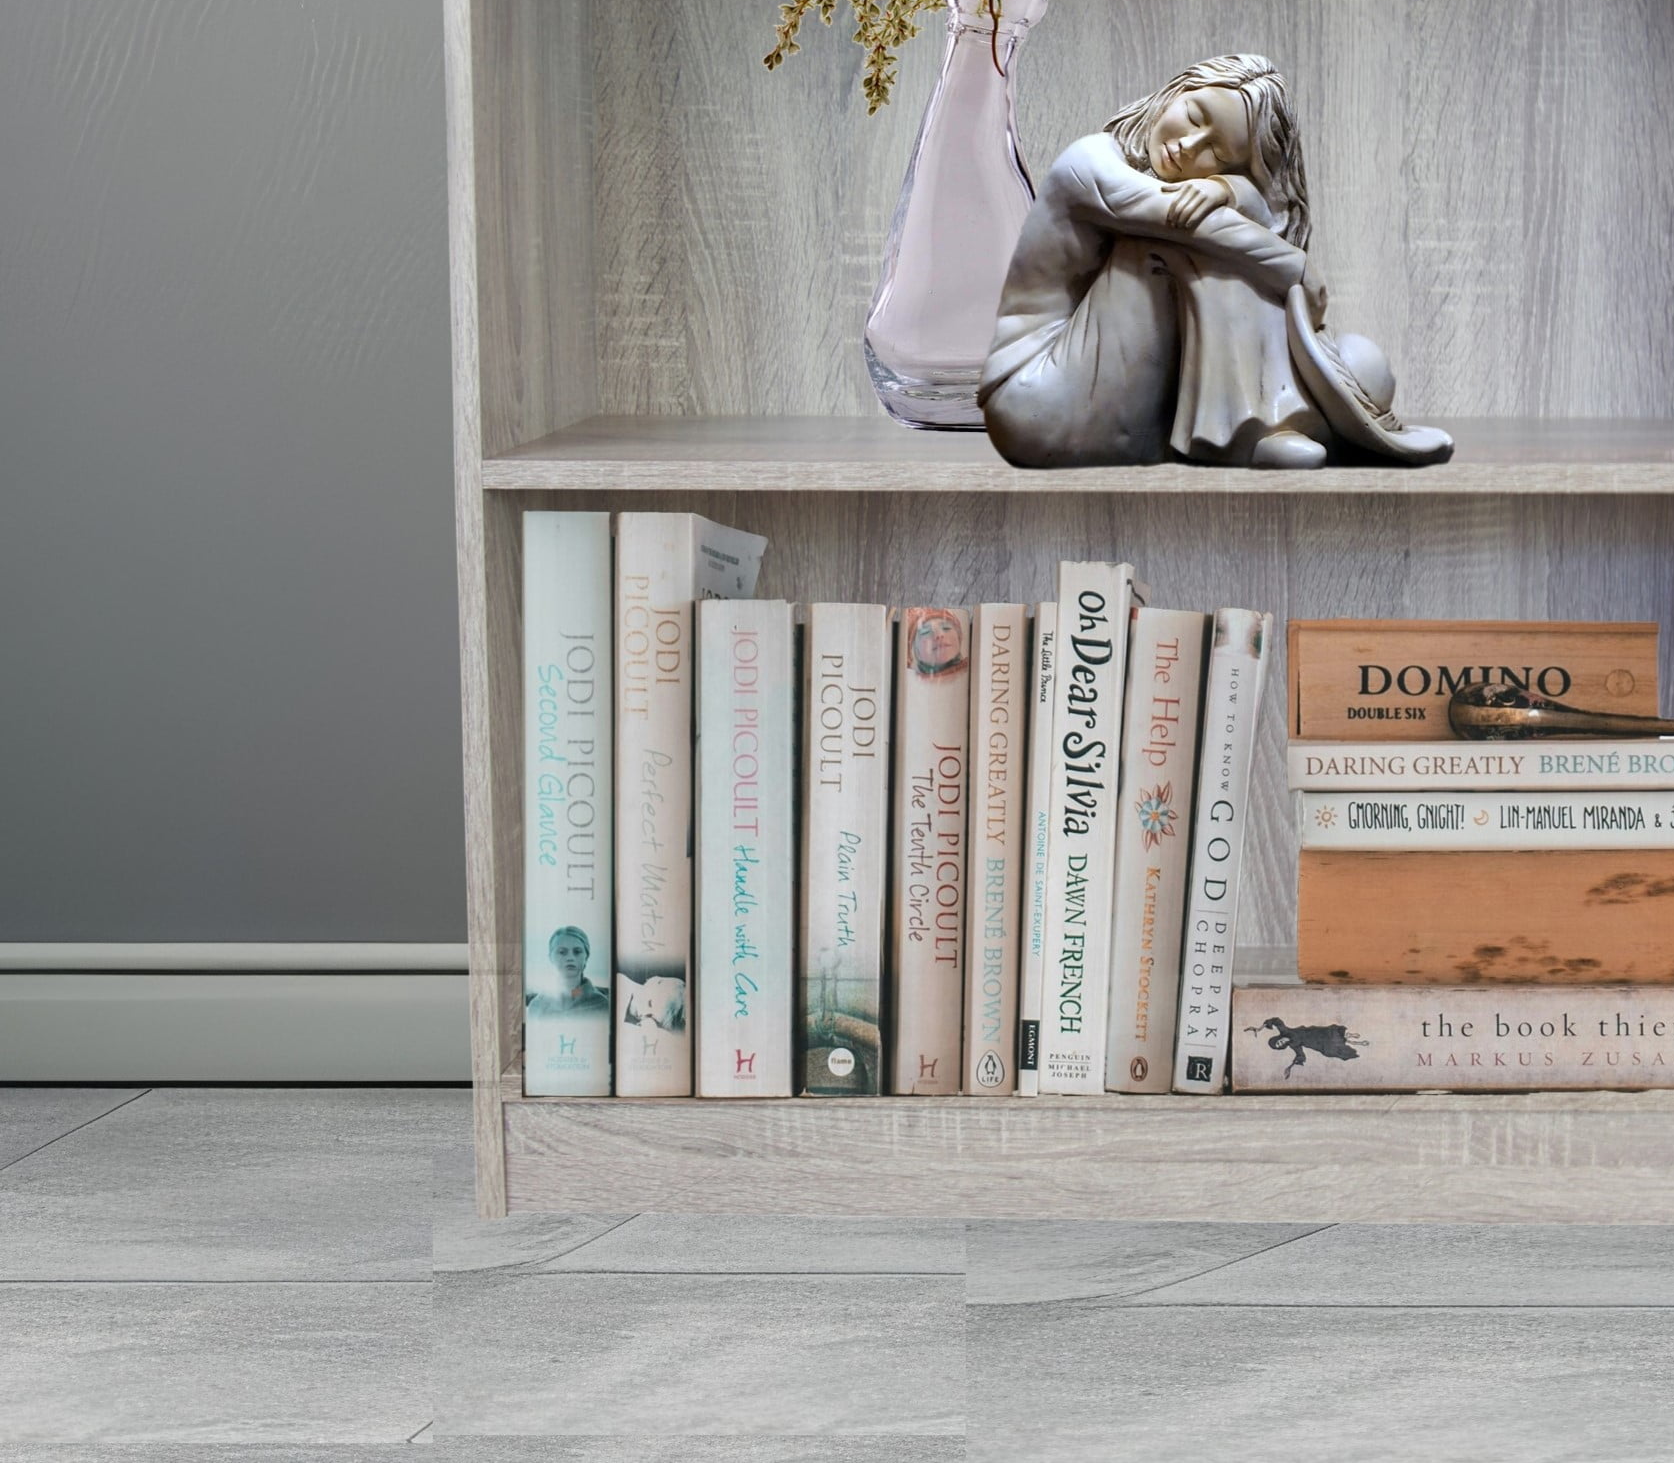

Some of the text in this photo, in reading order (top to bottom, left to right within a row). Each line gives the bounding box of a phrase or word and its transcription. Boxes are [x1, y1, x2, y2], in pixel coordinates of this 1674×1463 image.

[623, 575, 650, 720] PICOULT
[650, 607, 682, 684] JODI
[1039, 632, 1055, 703] The Little Prince
[1143, 637, 1180, 767] The Help
[1358, 665, 1572, 696] DOMINO
[537, 665, 565, 867] Second Glance
[560, 631, 595, 900] JODI PICOULT
[731, 629, 759, 837] JODI PICOULT
[819, 653, 844, 793] PICOULT
[849, 685, 876, 759] JODI
[1062, 590, 1113, 836] Oh Dear Silvia
[1220, 668, 1240, 792] HOW TO KNOW
[1305, 755, 1405, 776] DARING
[1413, 755, 1524, 776] GREATLY
[1538, 752, 1621, 774] BRENÉ
[1347, 706, 1427, 720] DOUBLE SIX
[641, 748, 672, 954] Perfect Match
[908, 768, 935, 942] The Tenth Circle
[934, 742, 962, 968] JODI PICOULT
[981, 624, 1012, 1043] DARING GREATLY BRENÉ BROWN
[1036, 862, 1045, 875] DE
[1037, 811, 1047, 857] ANTOINE
[1203, 799, 1235, 901] GOD
[1417, 803, 1465, 830] GNIGHT!
[1499, 805, 1576, 829] LIN-MANUEL
[1583, 806, 1645, 829] MIRANDA
[1654, 814, 1662, 828] &
[733, 845, 759, 1019] Handle with Care
[836, 831, 862, 948] Plain Truth
[1060, 854, 1088, 1035] DAWN FRENCH
[1135, 867, 1161, 1043] KATHRYN STOCKETT
[1186, 919, 1209, 1037] CHOPRA
[1205, 921, 1227, 1039] DEEPAK
[1026, 1024, 1036, 1067] EGMONT
[1047, 1064, 1091, 1072] MICHAEL
[1049, 1053, 1091, 1062] PENGUIN
[1417, 1052, 1556, 1067] MARKUS
[1421, 1014, 1474, 1037] the
[1495, 1013, 1576, 1037] book
